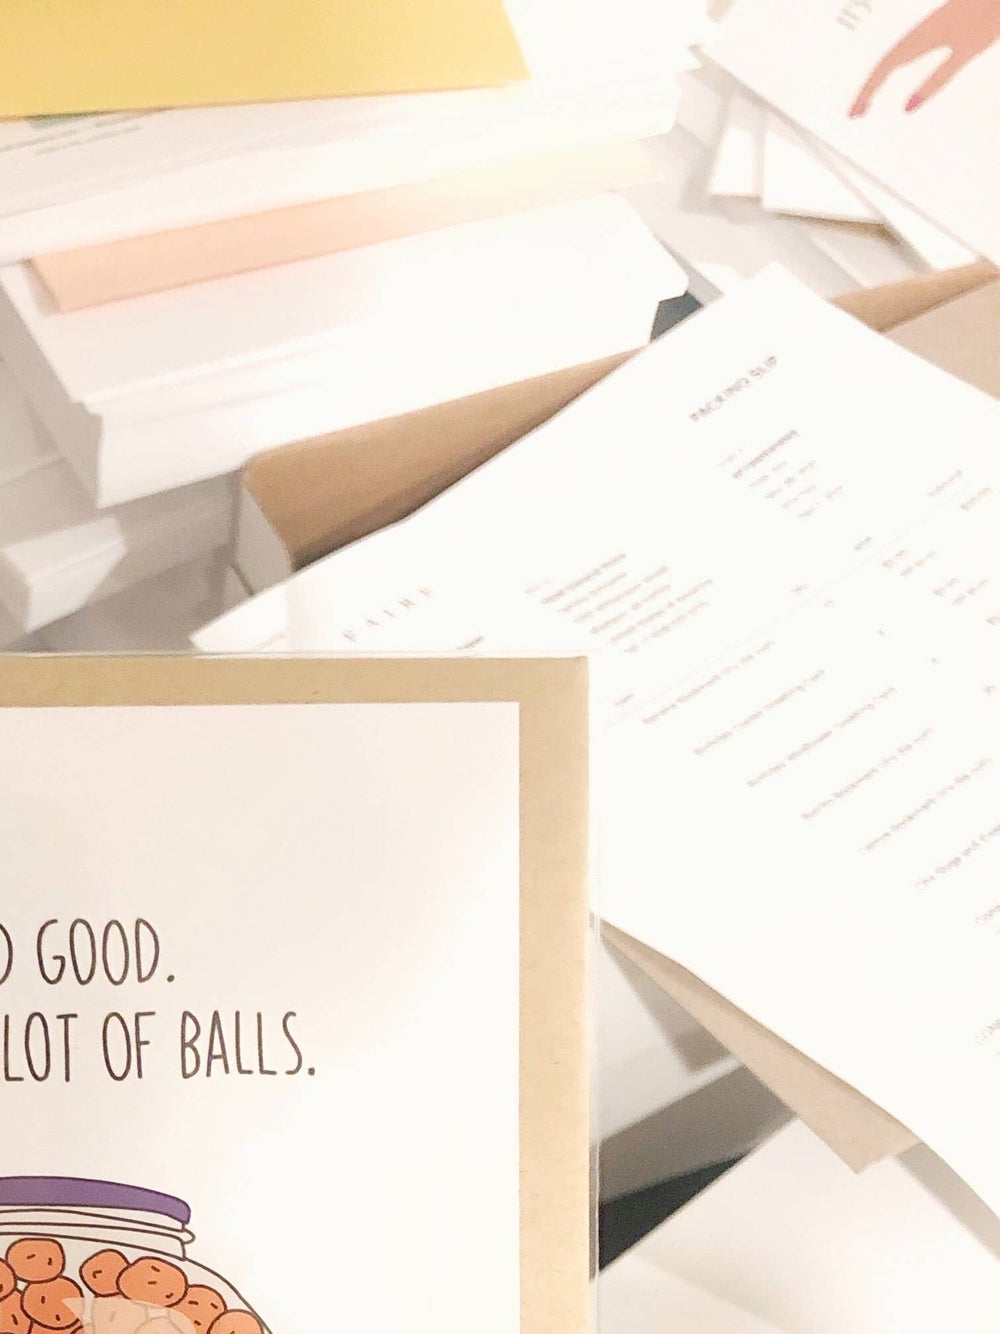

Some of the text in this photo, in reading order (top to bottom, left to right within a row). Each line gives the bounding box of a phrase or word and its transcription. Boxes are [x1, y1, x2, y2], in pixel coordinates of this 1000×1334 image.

[36, 918, 175, 986] GOOD.
[3, 1011, 78, 1083] LOT
[102, 1011, 156, 1082] OF
[180, 1010, 315, 1079] BALLS.
